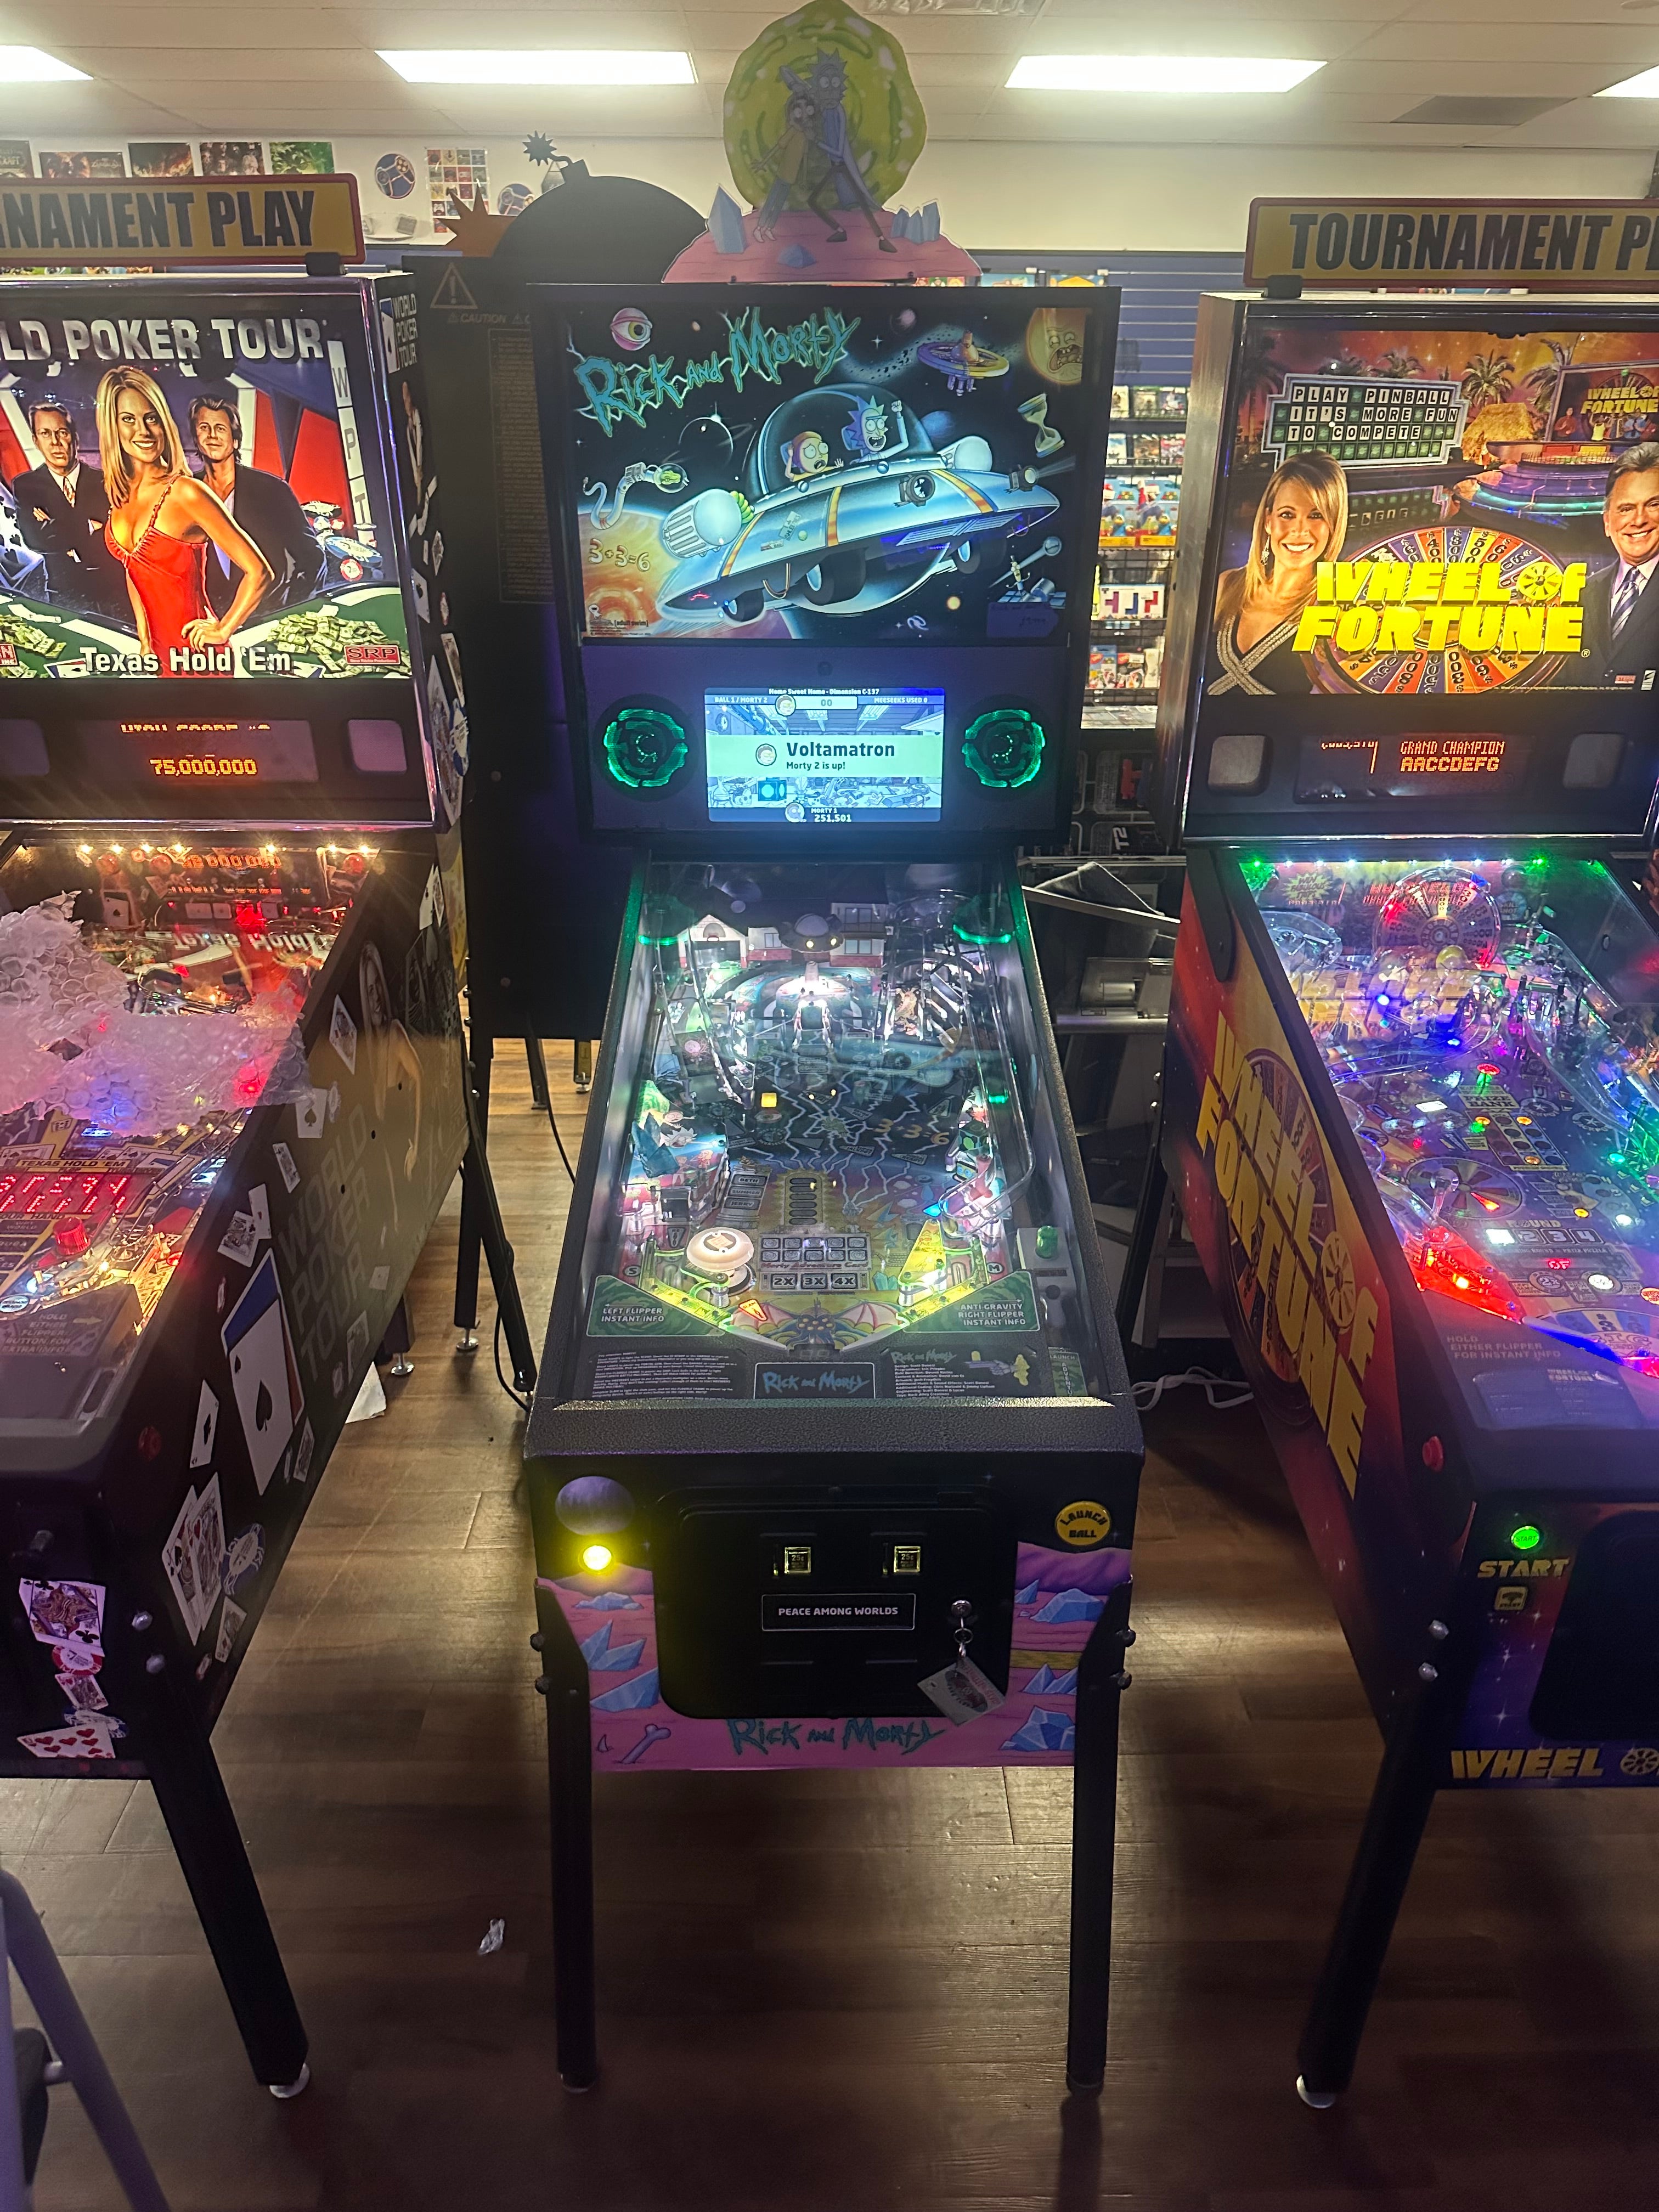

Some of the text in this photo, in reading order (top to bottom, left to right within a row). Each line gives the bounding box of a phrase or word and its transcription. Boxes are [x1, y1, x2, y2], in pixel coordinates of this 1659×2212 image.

[0, 190, 315, 248] NAMENT PLAY
[1289, 213, 1613, 270] TOURNAMENT
[393, 294, 417, 318] WORLD
[460, 313, 507, 324] CAUTION
[396, 317, 418, 343] POKER
[63, 318, 202, 360] POKER
[211, 318, 325, 359] TOUR
[399, 343, 417, 368] TOUR
[1295, 389, 1449, 403] PLAY PINBALL
[1588, 386, 1639, 400] WHEEL
[1580, 398, 1659, 415] FORTUNE
[1293, 408, 1458, 421] IT'S MORE FUN
[1291, 427, 1420, 439] TO COMPETE
[1316, 562, 1515, 603] WHEEL
[1292, 606, 1584, 655] FORTUNE
[80, 647, 159, 672] Texas
[170, 647, 233, 672] Hold
[348, 648, 396, 658] SRP
[786, 742, 895, 757] Voltamatron
[1400, 741, 1505, 755] GRAND CHAMPION
[149, 759, 258, 777] 75,000,000
[786, 761, 812, 771] Morty
[832, 761, 846, 771] up!
[1400, 757, 1500, 772] AACCDEFG
[814, 814, 852, 822] 251,501
[1553, 1231, 1567, 1242] 3
[1579, 1231, 1596, 1242] 4
[1062, 1362, 1074, 1397] ADVENTU
[1059, 1510, 1108, 1526] LAUNCH
[1069, 1530, 1097, 1538] BALL
[1477, 1558, 1571, 1578] START
[814, 1607, 851, 1616] AMONG
[854, 1607, 898, 1615] WORLDS
[1451, 1748, 1605, 1779] WHEEL
